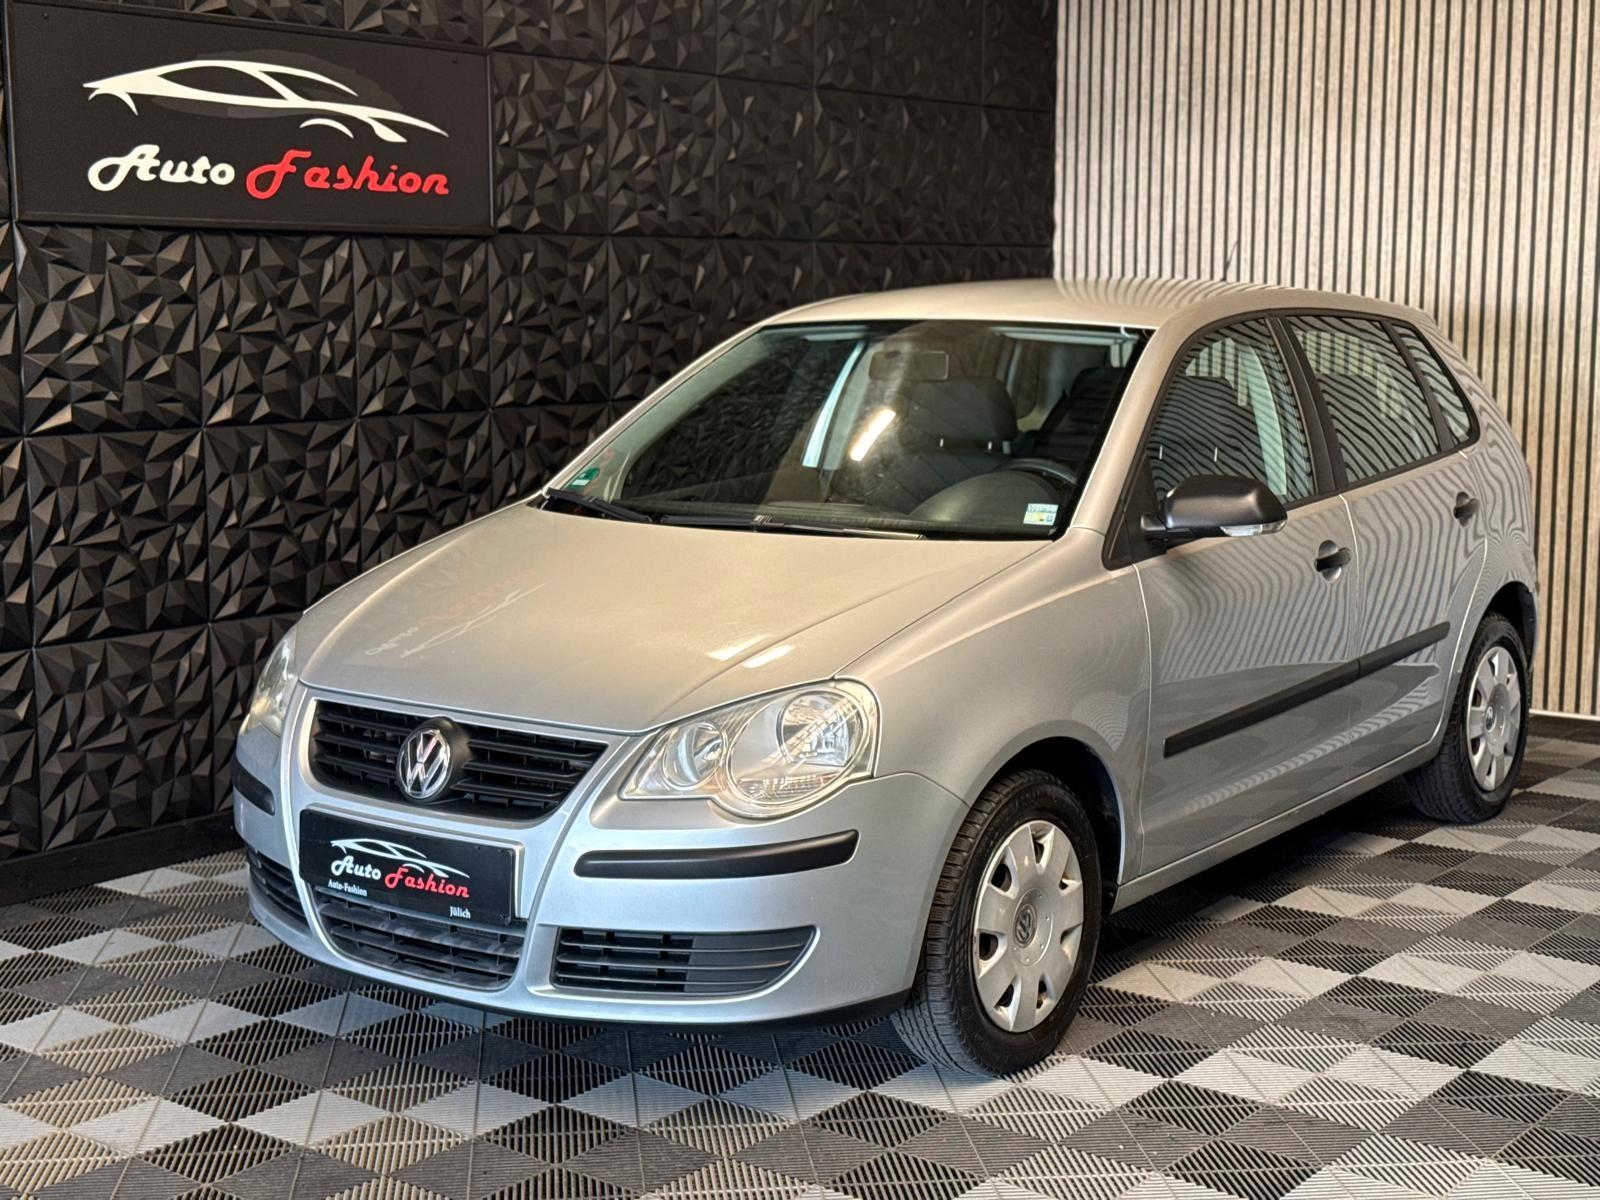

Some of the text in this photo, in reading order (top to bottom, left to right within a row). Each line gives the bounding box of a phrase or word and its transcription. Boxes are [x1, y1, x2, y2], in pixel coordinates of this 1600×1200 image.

[88, 144, 449, 199] Auto Fashion
[399, 729, 451, 798] VW
[328, 879, 368, 897] Auto-Fashion
[331, 855, 470, 898] Auto Fashion
[450, 906, 471, 919] Jülich
